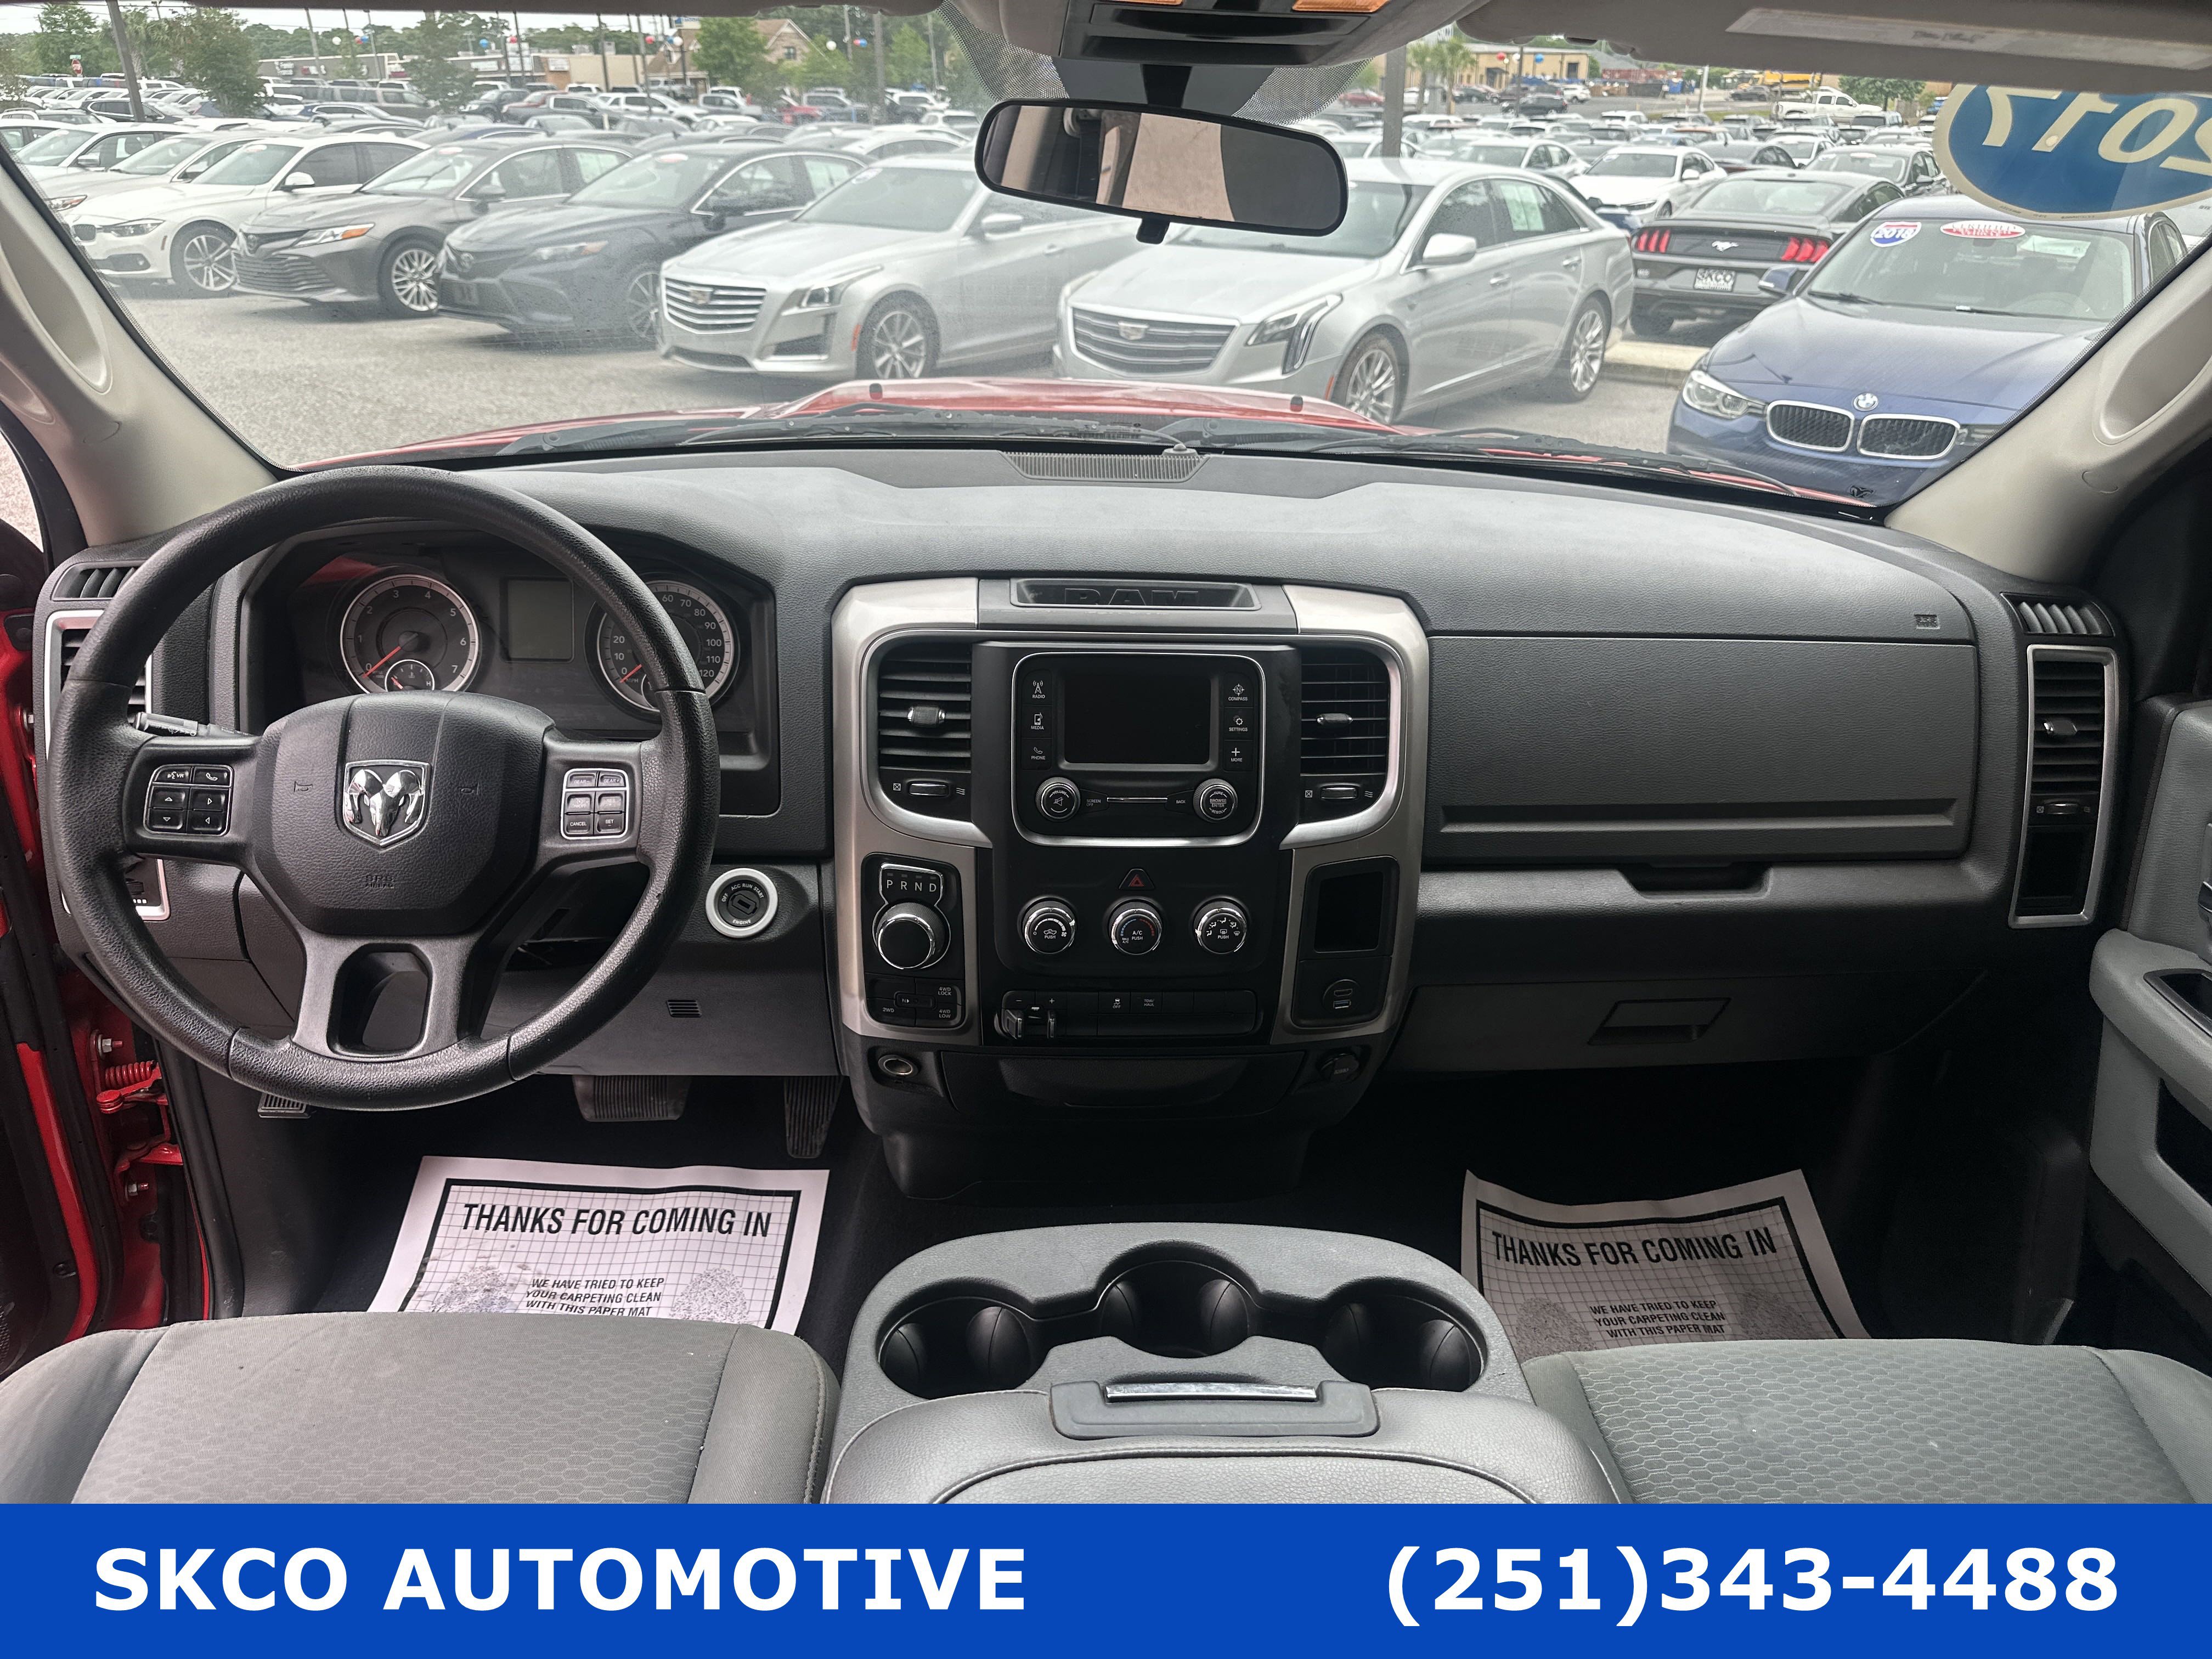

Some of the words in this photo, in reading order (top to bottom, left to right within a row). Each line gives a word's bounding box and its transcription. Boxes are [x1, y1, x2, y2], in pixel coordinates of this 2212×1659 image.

[393, 590, 399, 598] 3
[680, 599, 691, 607] 70
[450, 608, 456, 617] 5
[694, 608, 706, 617] 80
[358, 635, 363, 643] 1
[460, 637, 466, 646] 6
[706, 639, 722, 647] 100
[614, 652, 624, 661] 10
[706, 656, 721, 664] 110
[365, 663, 372, 672] 0
[452, 665, 458, 673] 7
[699, 669, 714, 678] 120
[887, 879, 893, 889] P
[901, 881, 907, 890] R
[915, 882, 922, 891] N
[929, 883, 936, 892] D
[753, 886, 764, 898] START
[462, 1204, 565, 1234] THANKS
[571, 1209, 625, 1235] FOR
[631, 1207, 736, 1235] COMING
[743, 1211, 772, 1237] IN
[1492, 1231, 1581, 1266] THANKS
[1585, 1241, 1640, 1265] FOR
[1643, 1233, 1743, 1263] COMING
[1746, 1227, 1777, 1256] IN
[532, 1278, 550, 1288] WE
[551, 1279, 582, 1289] HAVE
[585, 1279, 616, 1289] TRIED
[620, 1279, 633, 1289] TO
[636, 1278, 664, 1288] KEEP
[525, 1290, 557, 1299] YOUR
[560, 1292, 622, 1304] CARPETING
[627, 1291, 662, 1303] CLEAN
[526, 1300, 557, 1310] WITH
[560, 1302, 585, 1314] THIS
[588, 1306, 624, 1316] PAPER
[628, 1306, 652, 1317] MAT
[1590, 1306, 1609, 1314] WE
[1610, 1304, 1639, 1313] HAVE
[1640, 1302, 1672, 1312] TRIED
[1674, 1301, 1689, 1310] TO
[1690, 1300, 1717, 1309] KEEP
[1594, 1317, 1627, 1327] YOUR
[1629, 1312, 1689, 1324] CARPETING
[1691, 1312, 1725, 1322] CLEAN
[1606, 1328, 1637, 1338] WITH
[1638, 1326, 1664, 1335] THIS
[1666, 1324, 1702, 1334] PAPER
[1703, 1324, 1725, 1334] MAT
